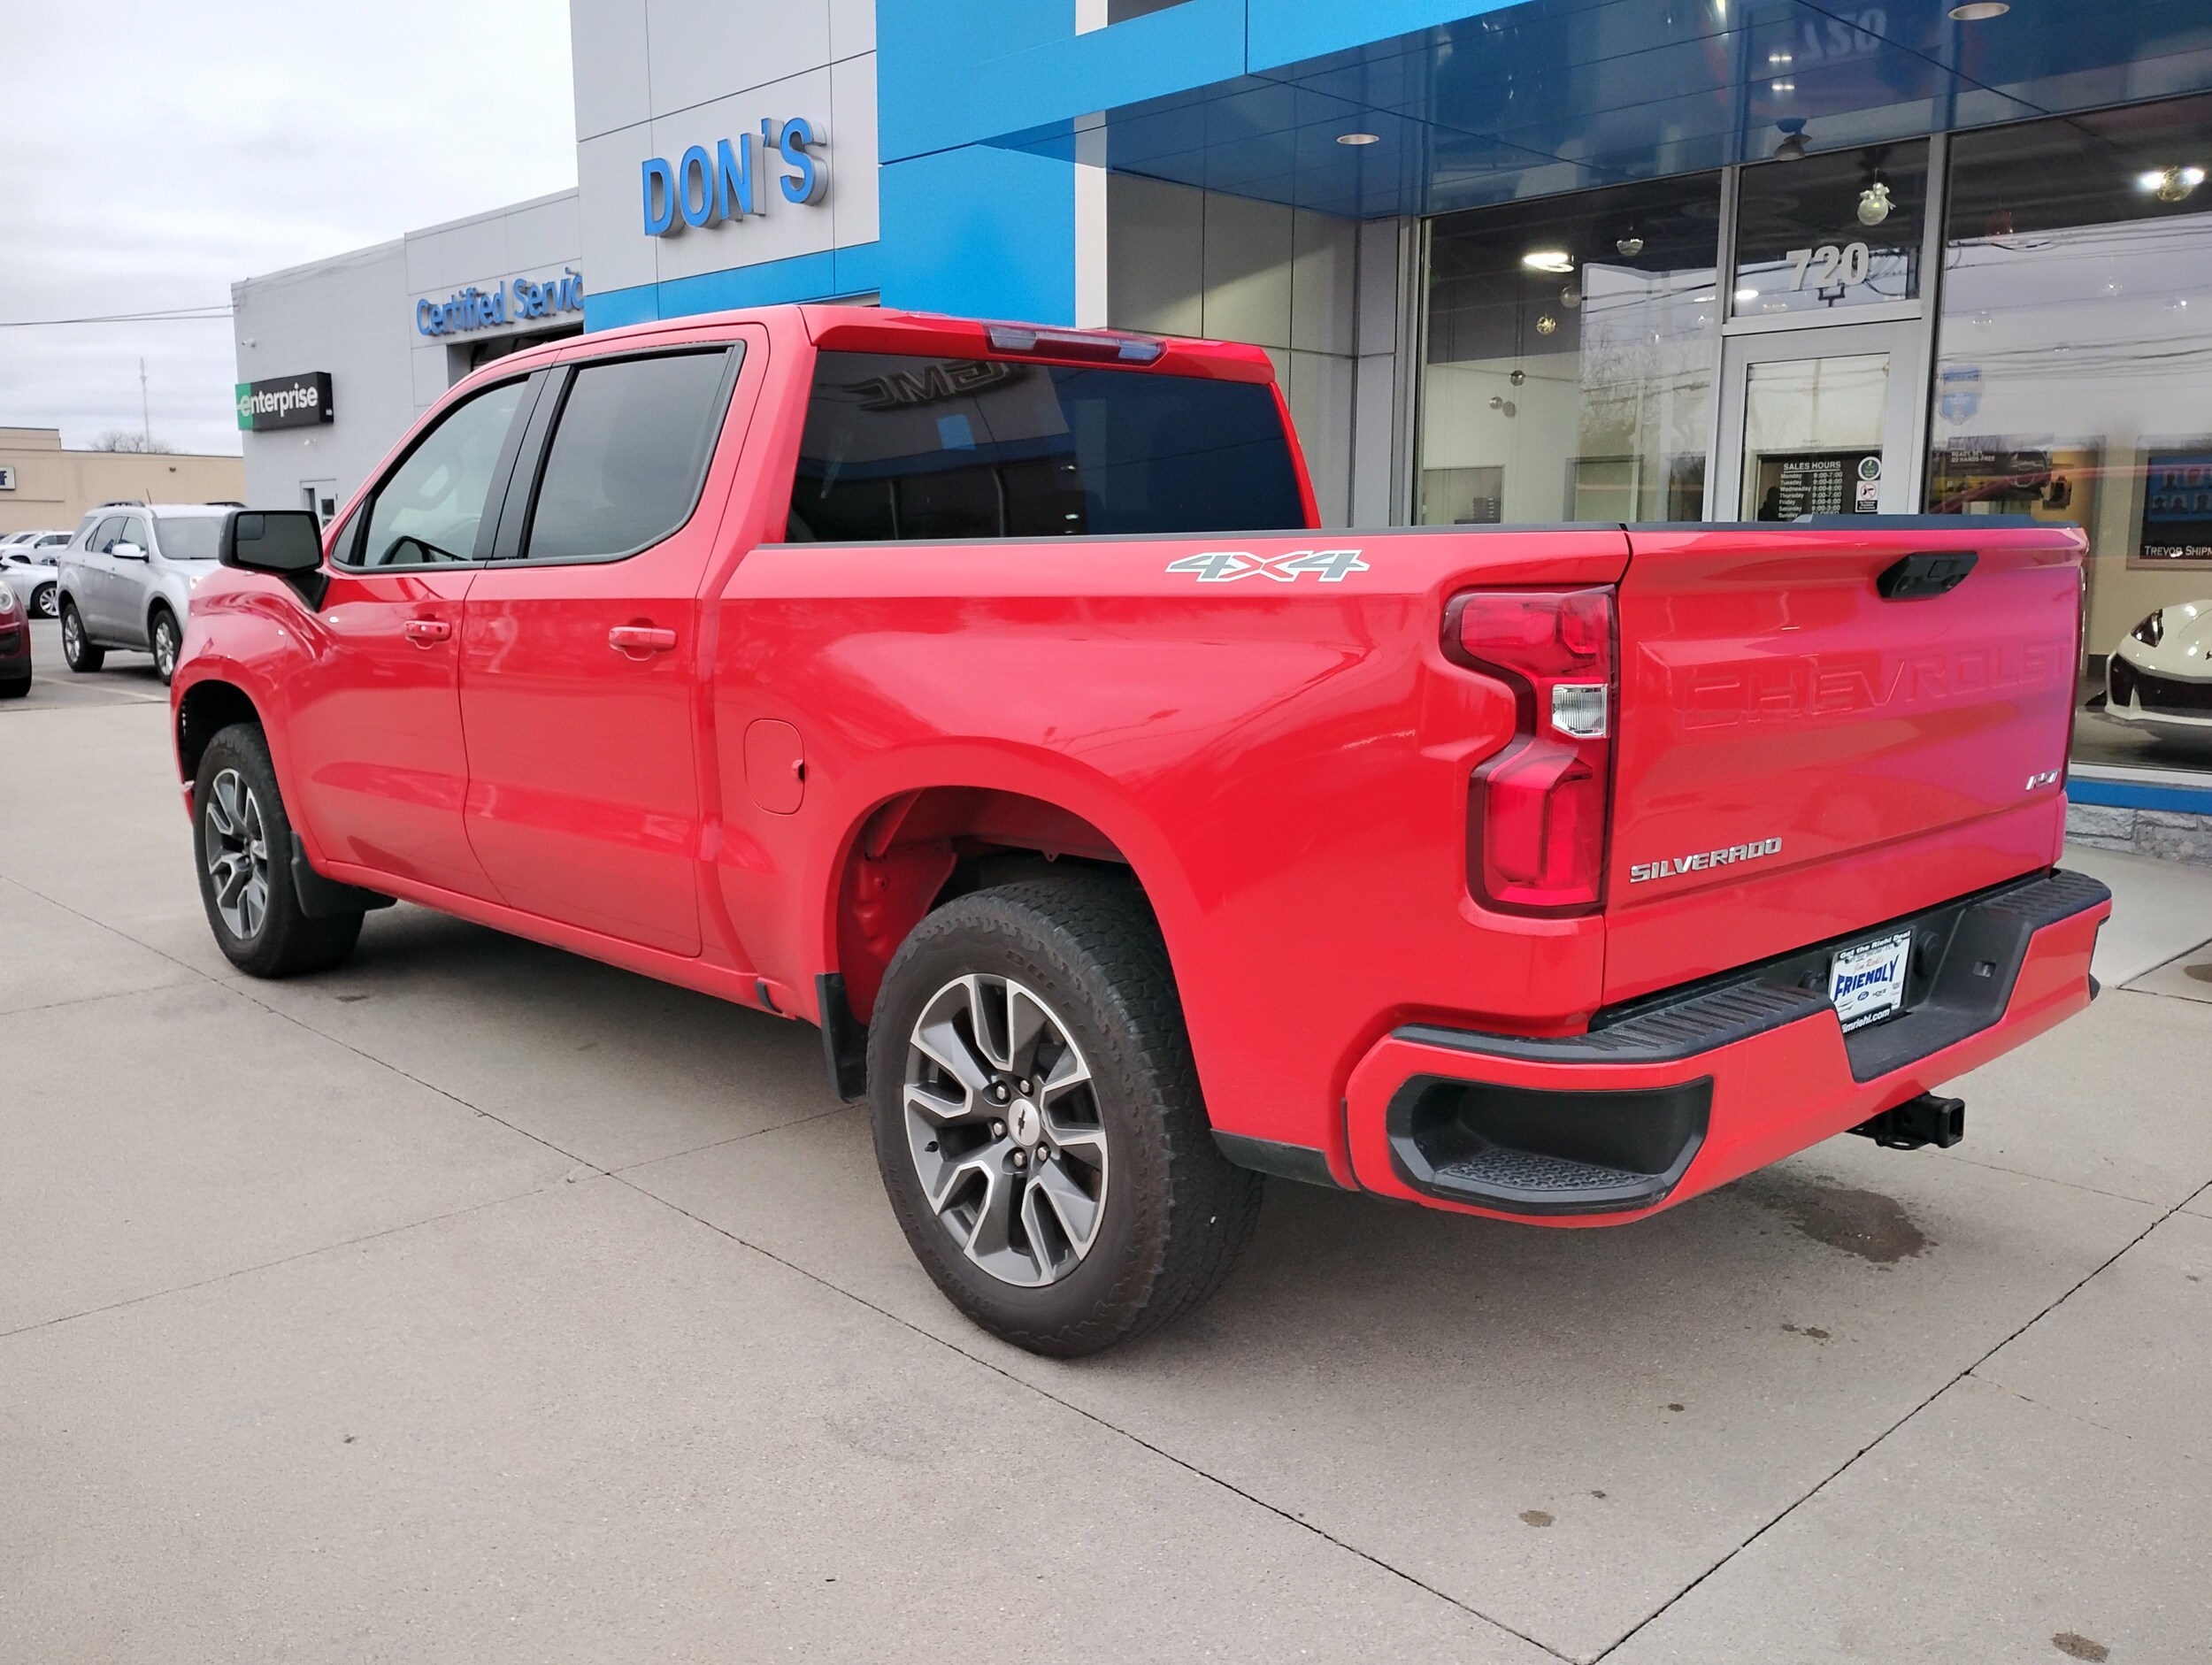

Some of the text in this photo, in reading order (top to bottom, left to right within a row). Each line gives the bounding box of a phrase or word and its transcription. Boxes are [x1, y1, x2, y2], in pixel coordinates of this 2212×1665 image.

[641, 117, 822, 236] DON'S
[1786, 242, 1869, 290] 720
[417, 280, 505, 336] Certified
[240, 381, 319, 418] enterprise
[1783, 461, 1841, 471] SALES HOURS
[2144, 545, 2183, 556] TREVOR
[1684, 637, 2071, 732] CHEVROLET
[1630, 837, 1782, 883] SILVERADO
[1856, 945, 1870, 954] the
[1833, 954, 1900, 1002] FRIENDLY
